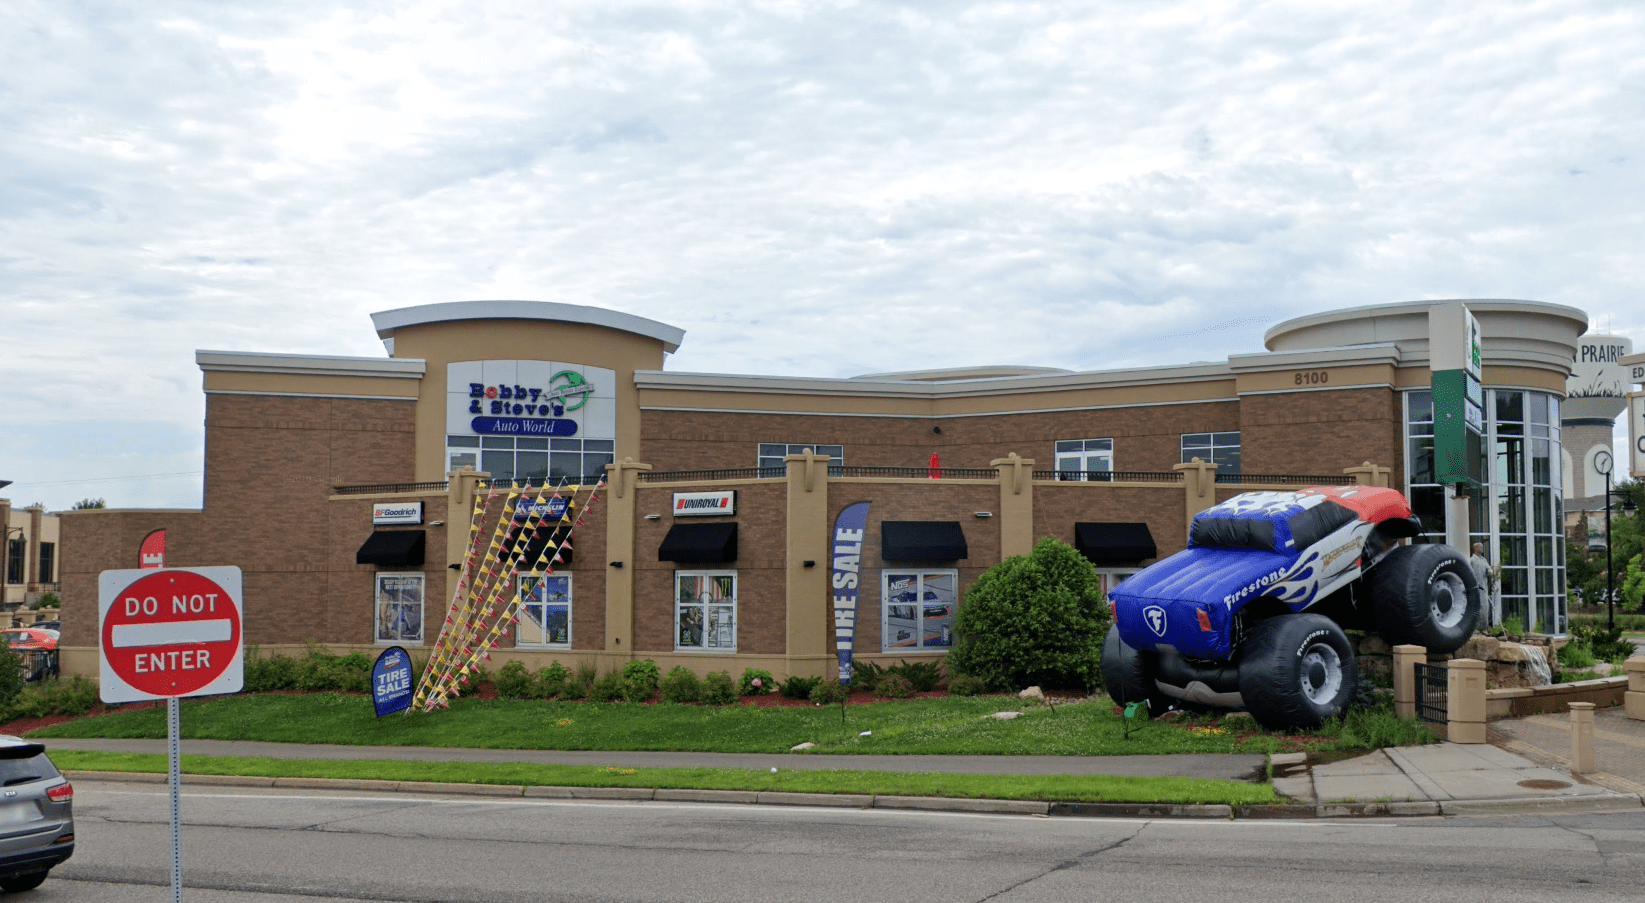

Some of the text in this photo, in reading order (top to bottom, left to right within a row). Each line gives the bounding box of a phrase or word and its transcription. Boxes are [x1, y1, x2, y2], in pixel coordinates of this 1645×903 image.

[1294, 371, 1329, 385] 8100
[469, 383, 542, 402] Bobby
[469, 399, 564, 417] & Steve's
[492, 419, 555, 433] Auto World
[374, 508, 417, 517] BFGoodrich
[527, 503, 566, 512] MICHLIN
[684, 498, 720, 509] UNIROYAL
[832, 528, 864, 590] SALE
[890, 579, 910, 591] NOS
[1223, 566, 1287, 612] Firestone
[125, 593, 218, 617] DO NOT
[1296, 629, 1325, 656] Firestone
[135, 649, 210, 673] ENTER
[377, 667, 408, 685] TIRE
[376, 677, 410, 696] SALE
